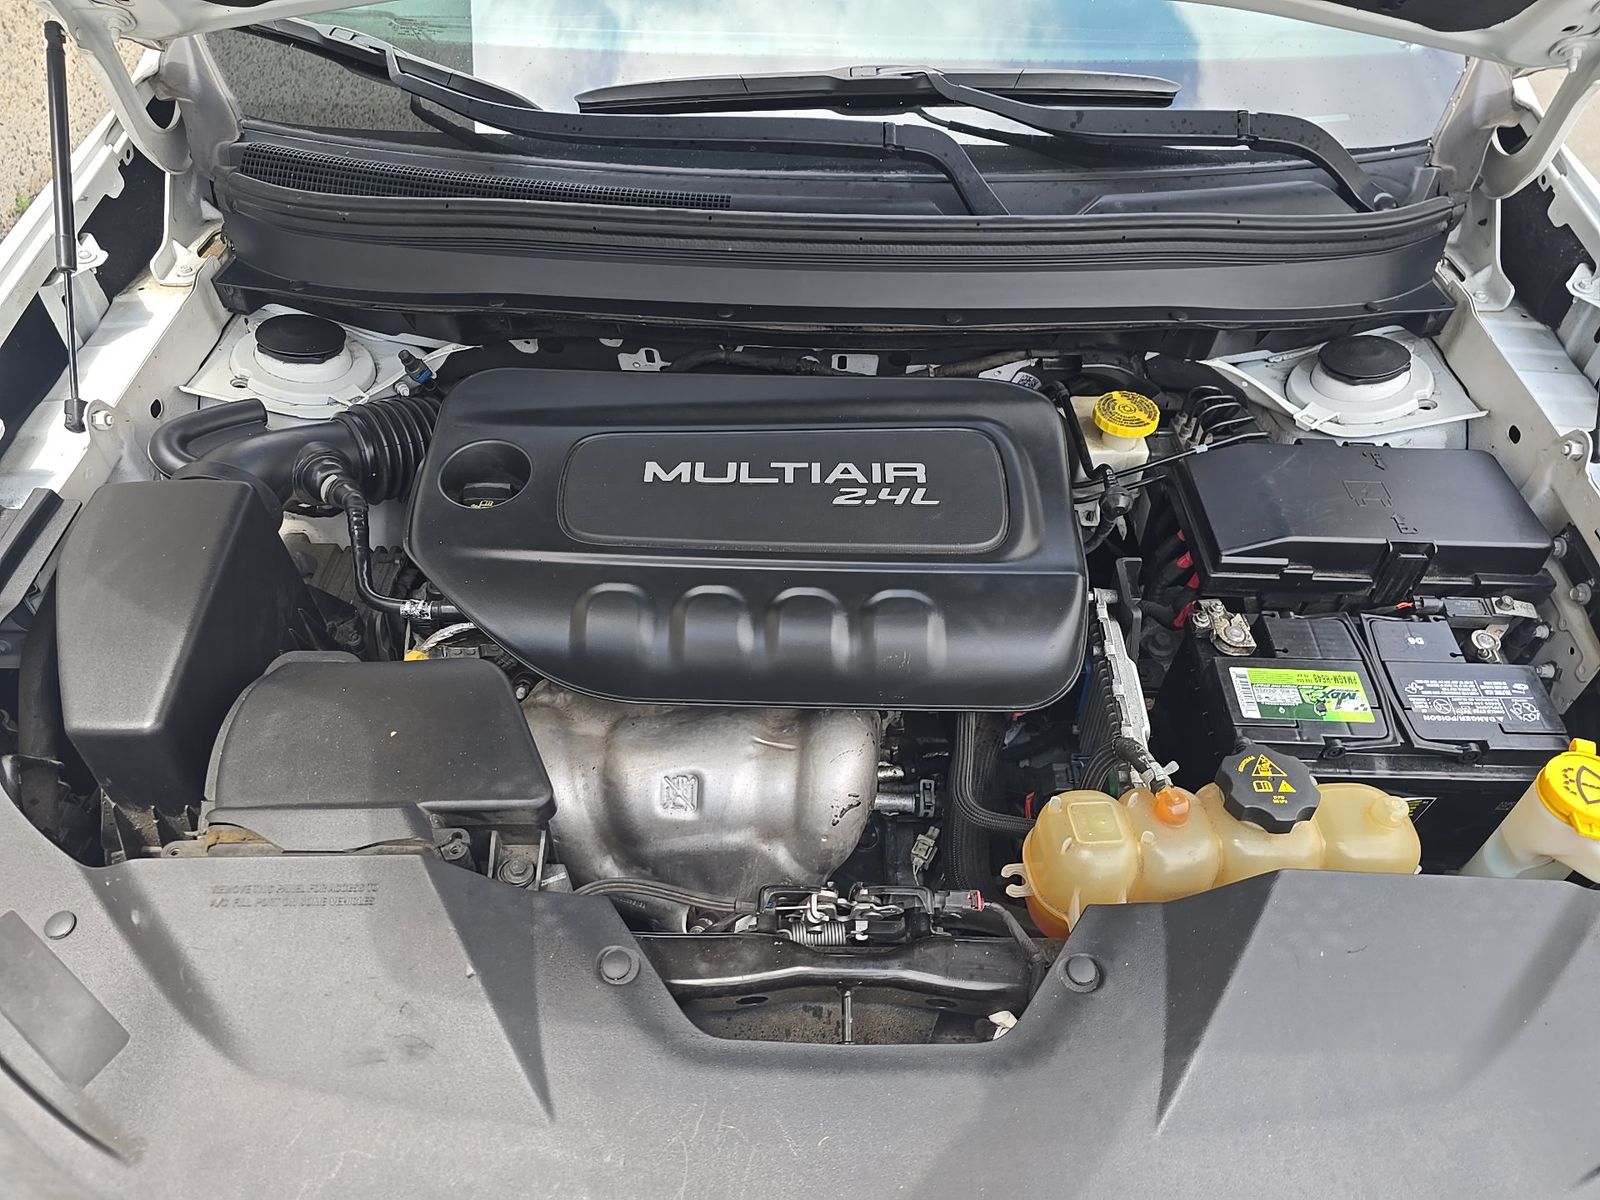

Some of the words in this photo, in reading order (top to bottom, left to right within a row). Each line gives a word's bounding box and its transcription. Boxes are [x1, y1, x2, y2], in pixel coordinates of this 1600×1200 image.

[643, 461, 927, 484] MULTIAIR
[832, 487, 941, 505] 2.4L
[1423, 714, 1496, 722] DANGER/POISON
